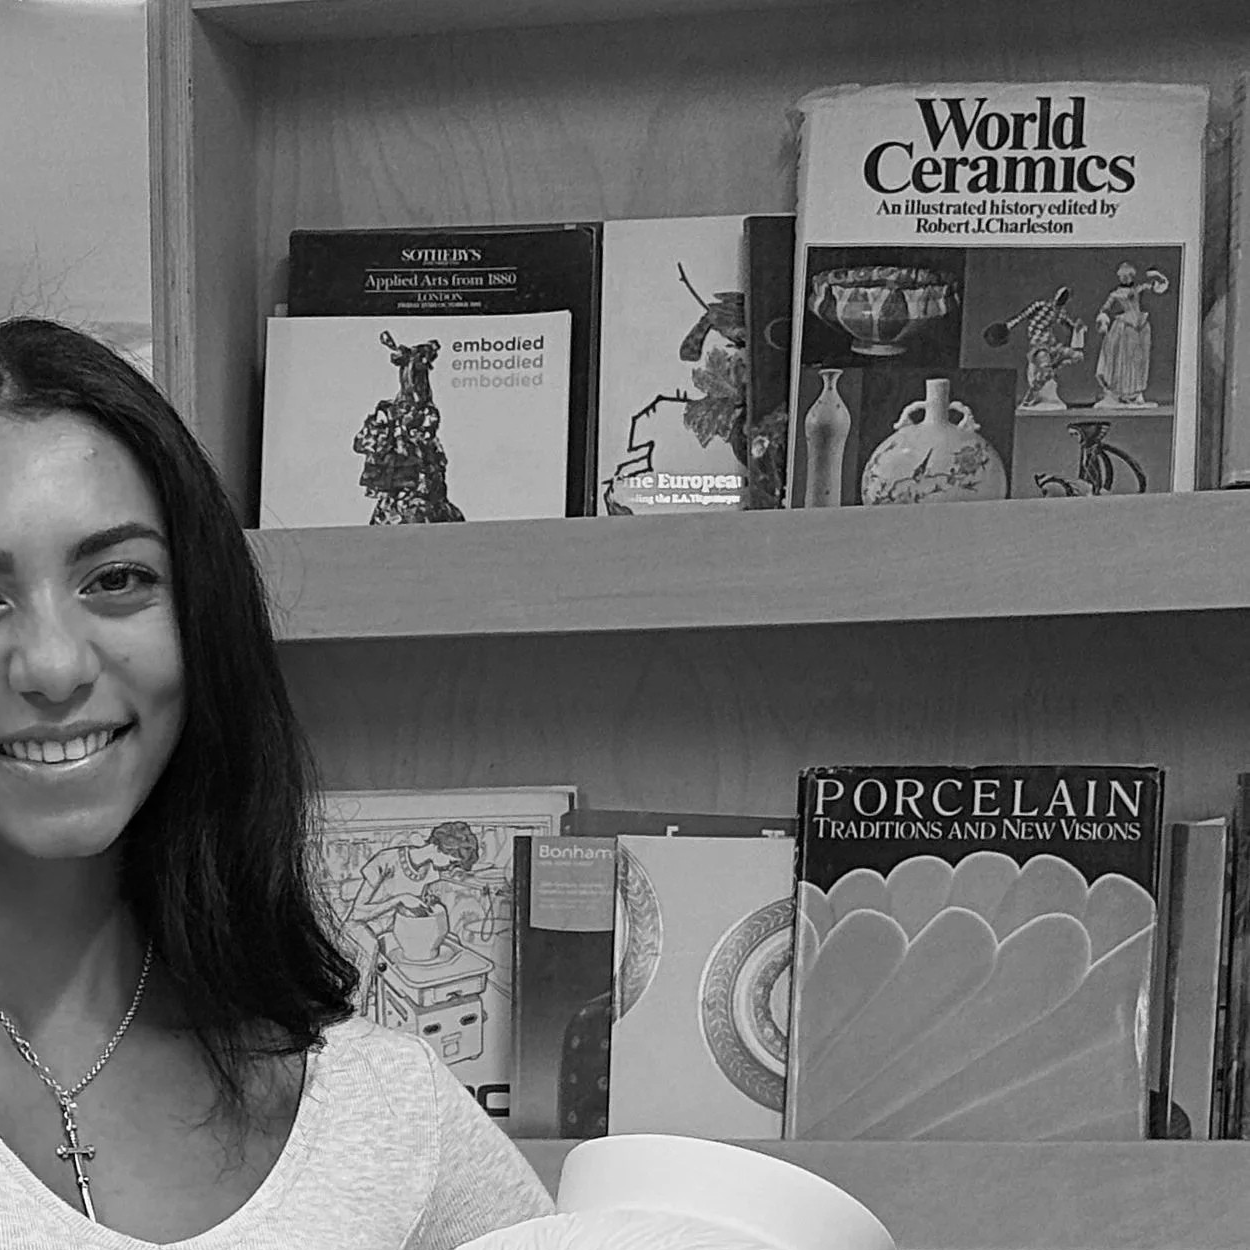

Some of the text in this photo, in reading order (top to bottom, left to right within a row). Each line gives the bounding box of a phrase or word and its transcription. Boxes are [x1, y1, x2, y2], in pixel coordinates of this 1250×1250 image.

[916, 97, 1087, 151] World
[863, 142, 1136, 194] Ceramics
[876, 199, 1119, 219] An illustrated history edited by
[915, 218, 970, 234] Robert
[401, 248, 482, 262] SOTHEBY'S
[364, 272, 518, 291] Applied Arts from 1880
[417, 292, 463, 301] LONDON
[451, 335, 545, 353] embodied
[451, 353, 544, 371] embodied
[451, 372, 544, 389] embodied
[813, 778, 1145, 818] PORCELAIN
[812, 816, 943, 840] TRADITIONS
[949, 821, 997, 840] AND
[1001, 818, 1057, 841] NEW
[1060, 818, 1141, 841] VISIONS
